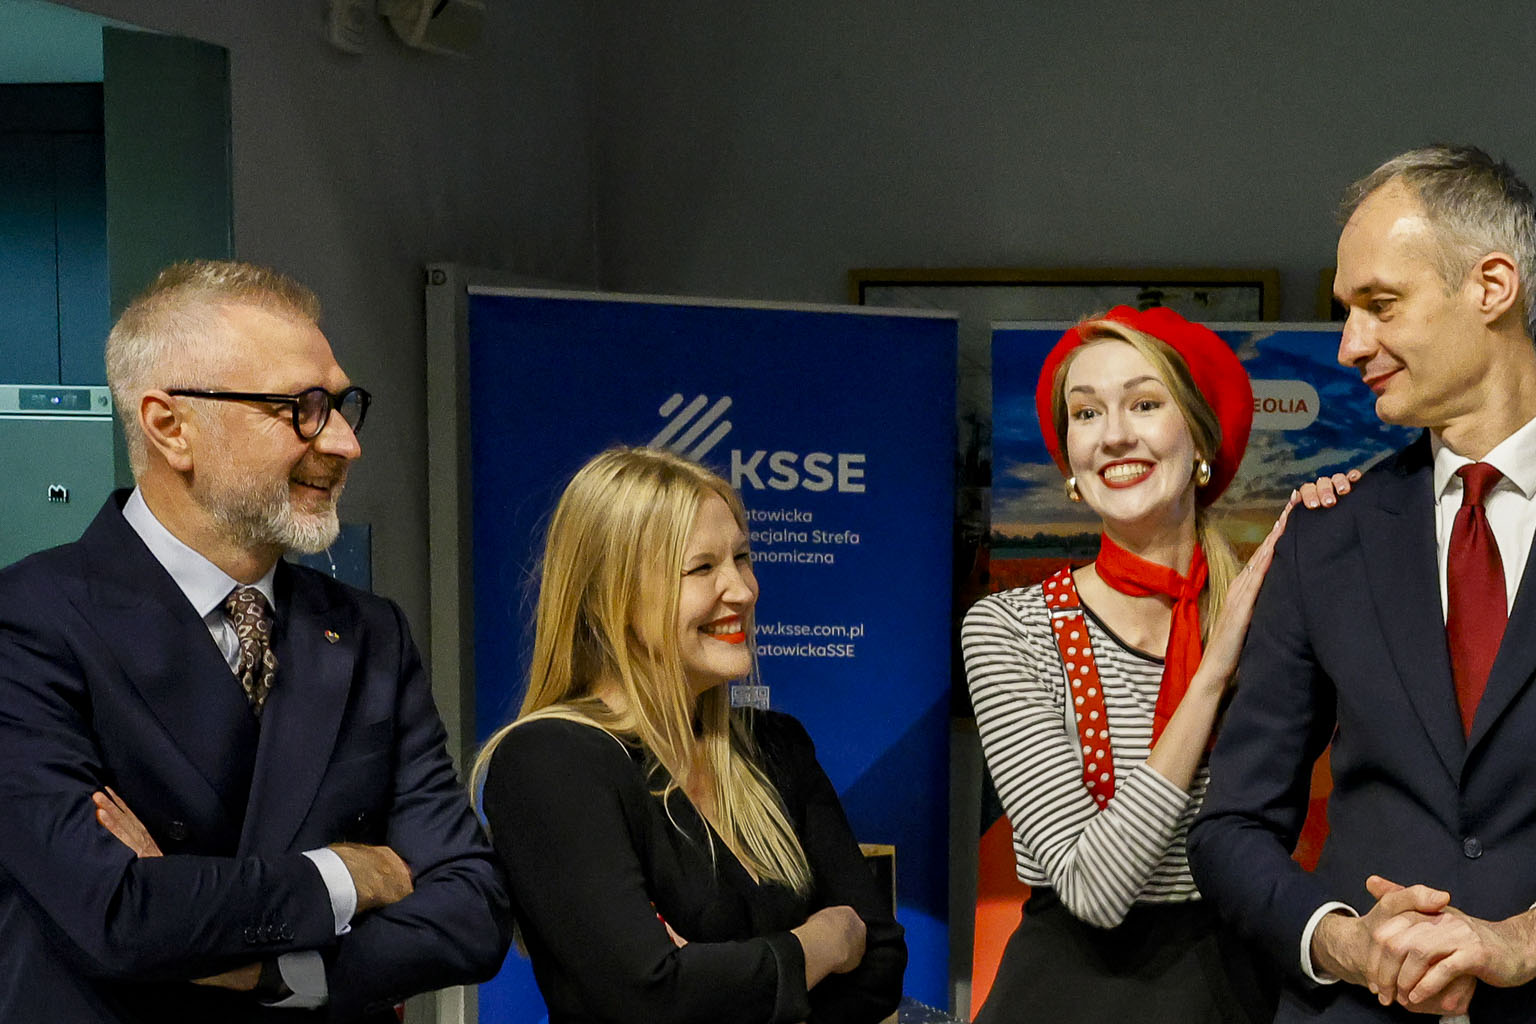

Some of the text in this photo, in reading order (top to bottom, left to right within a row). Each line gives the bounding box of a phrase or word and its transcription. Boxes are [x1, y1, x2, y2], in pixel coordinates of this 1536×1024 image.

[1253, 397, 1309, 414] EOLIA
[731, 449, 866, 493] KSSE
[750, 528, 860, 545] ecjalna Strefa
[750, 549, 834, 564] onomiczna
[755, 621, 865, 640] w.ksse.com.pl
[757, 643, 856, 658] atowickaSSE
